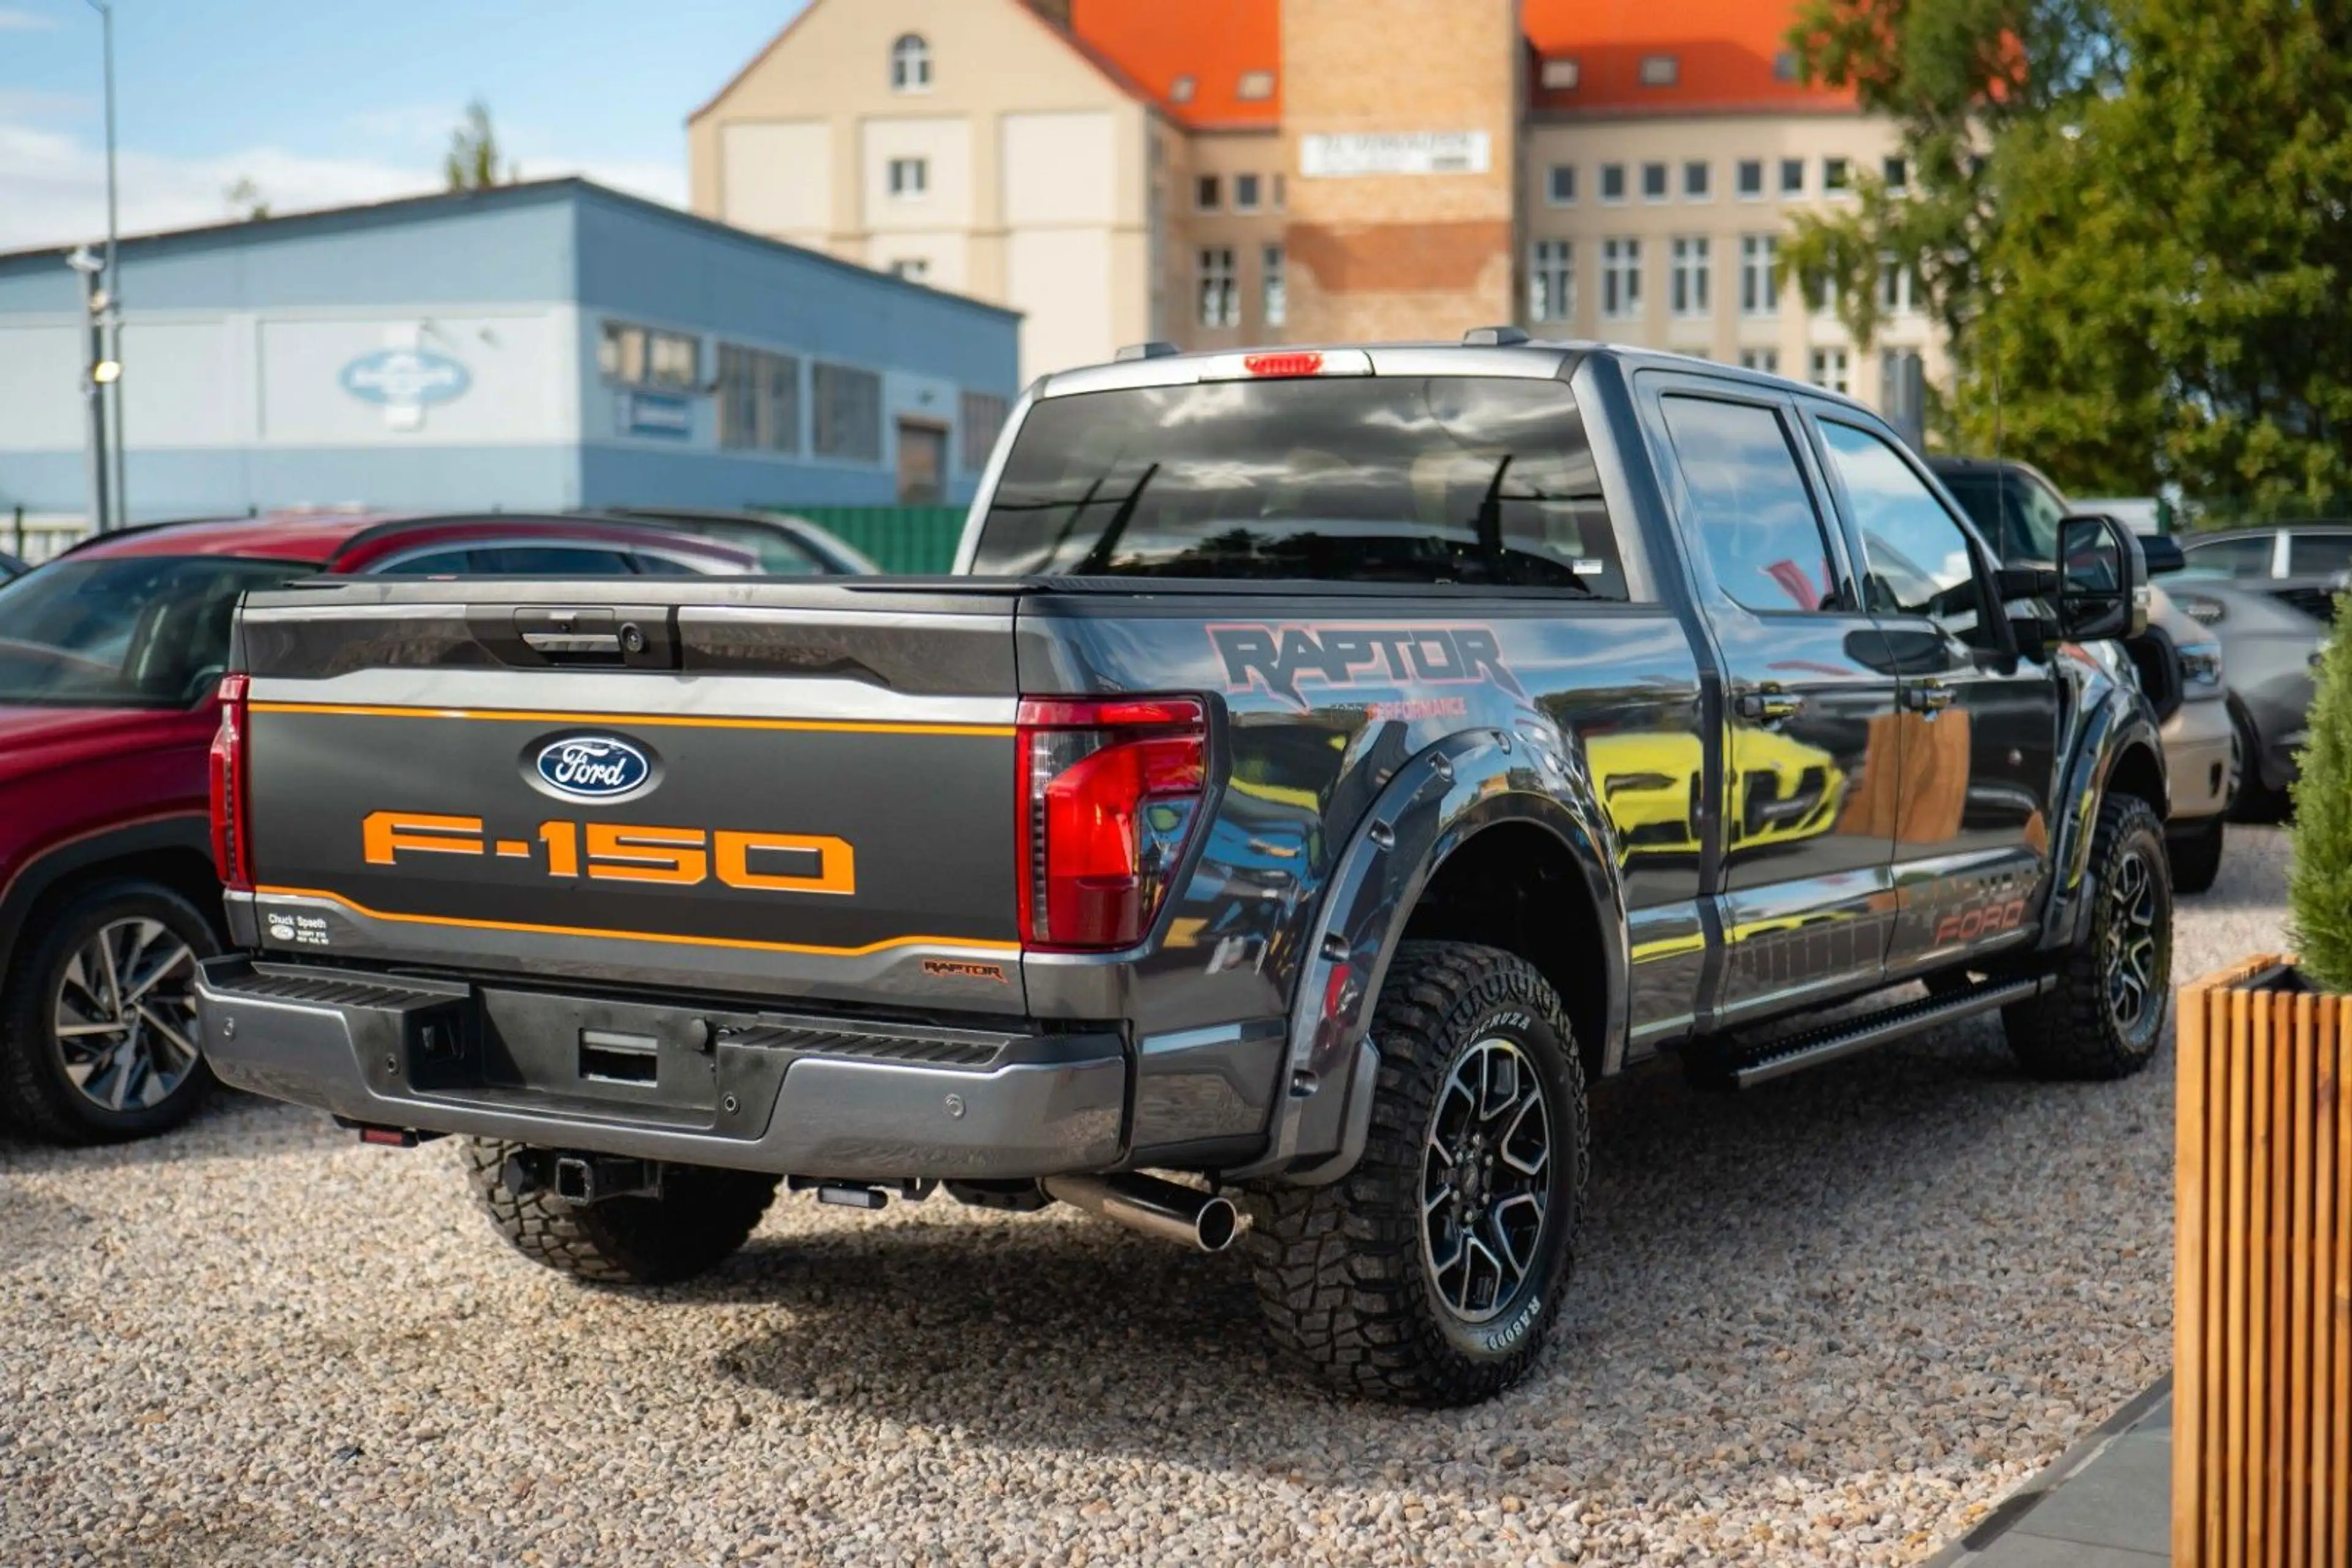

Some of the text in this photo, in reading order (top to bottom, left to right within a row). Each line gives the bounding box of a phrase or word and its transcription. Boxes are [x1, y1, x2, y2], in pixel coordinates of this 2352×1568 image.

[1204, 624, 1536, 715] RAPTOR
[554, 743, 625, 786] Ford
[363, 810, 856, 896] F-150
[268, 913, 294, 926] Chuck
[1934, 899, 2025, 946] FORD
[922, 959, 1009, 984] RAPTOR
